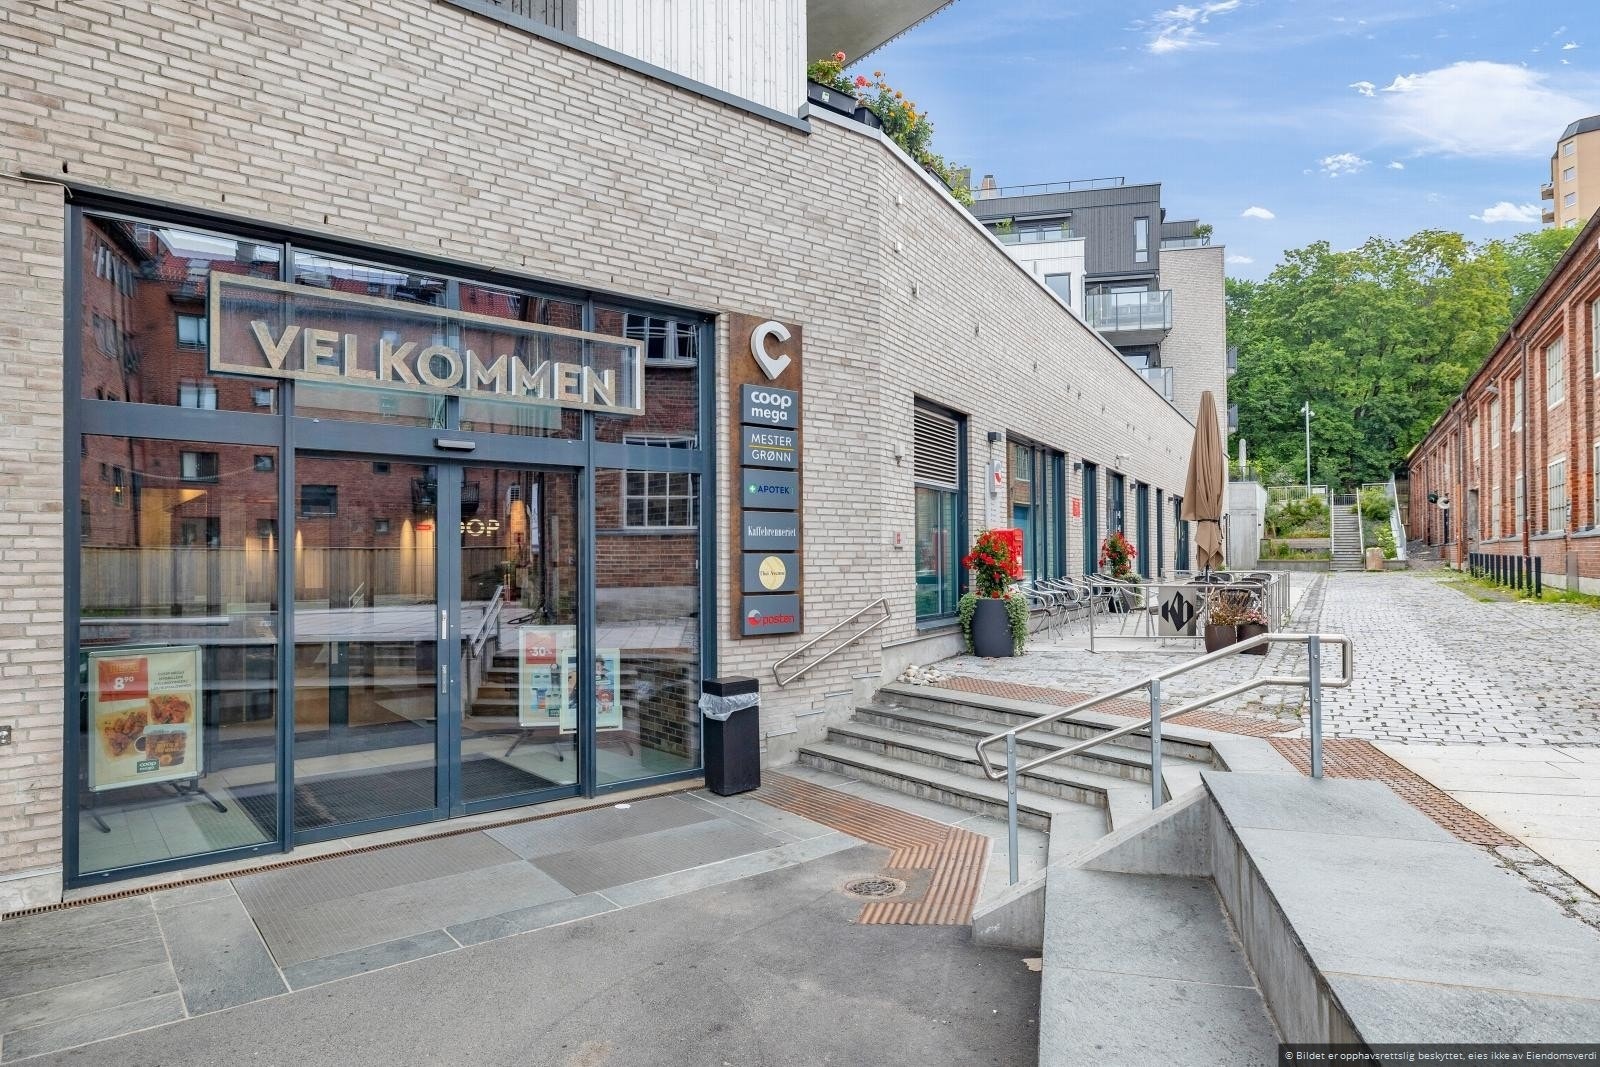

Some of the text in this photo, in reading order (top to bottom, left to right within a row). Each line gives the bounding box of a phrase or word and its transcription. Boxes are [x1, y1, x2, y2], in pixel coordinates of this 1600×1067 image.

[250, 320, 616, 408] VELKOMMEN
[751, 391, 792, 409] coop
[751, 407, 788, 423] mega
[751, 433, 792, 447] MESTER
[751, 449, 791, 463] GRØNN
[757, 485, 790, 495] APOTEK
[761, 613, 795, 627] posten
